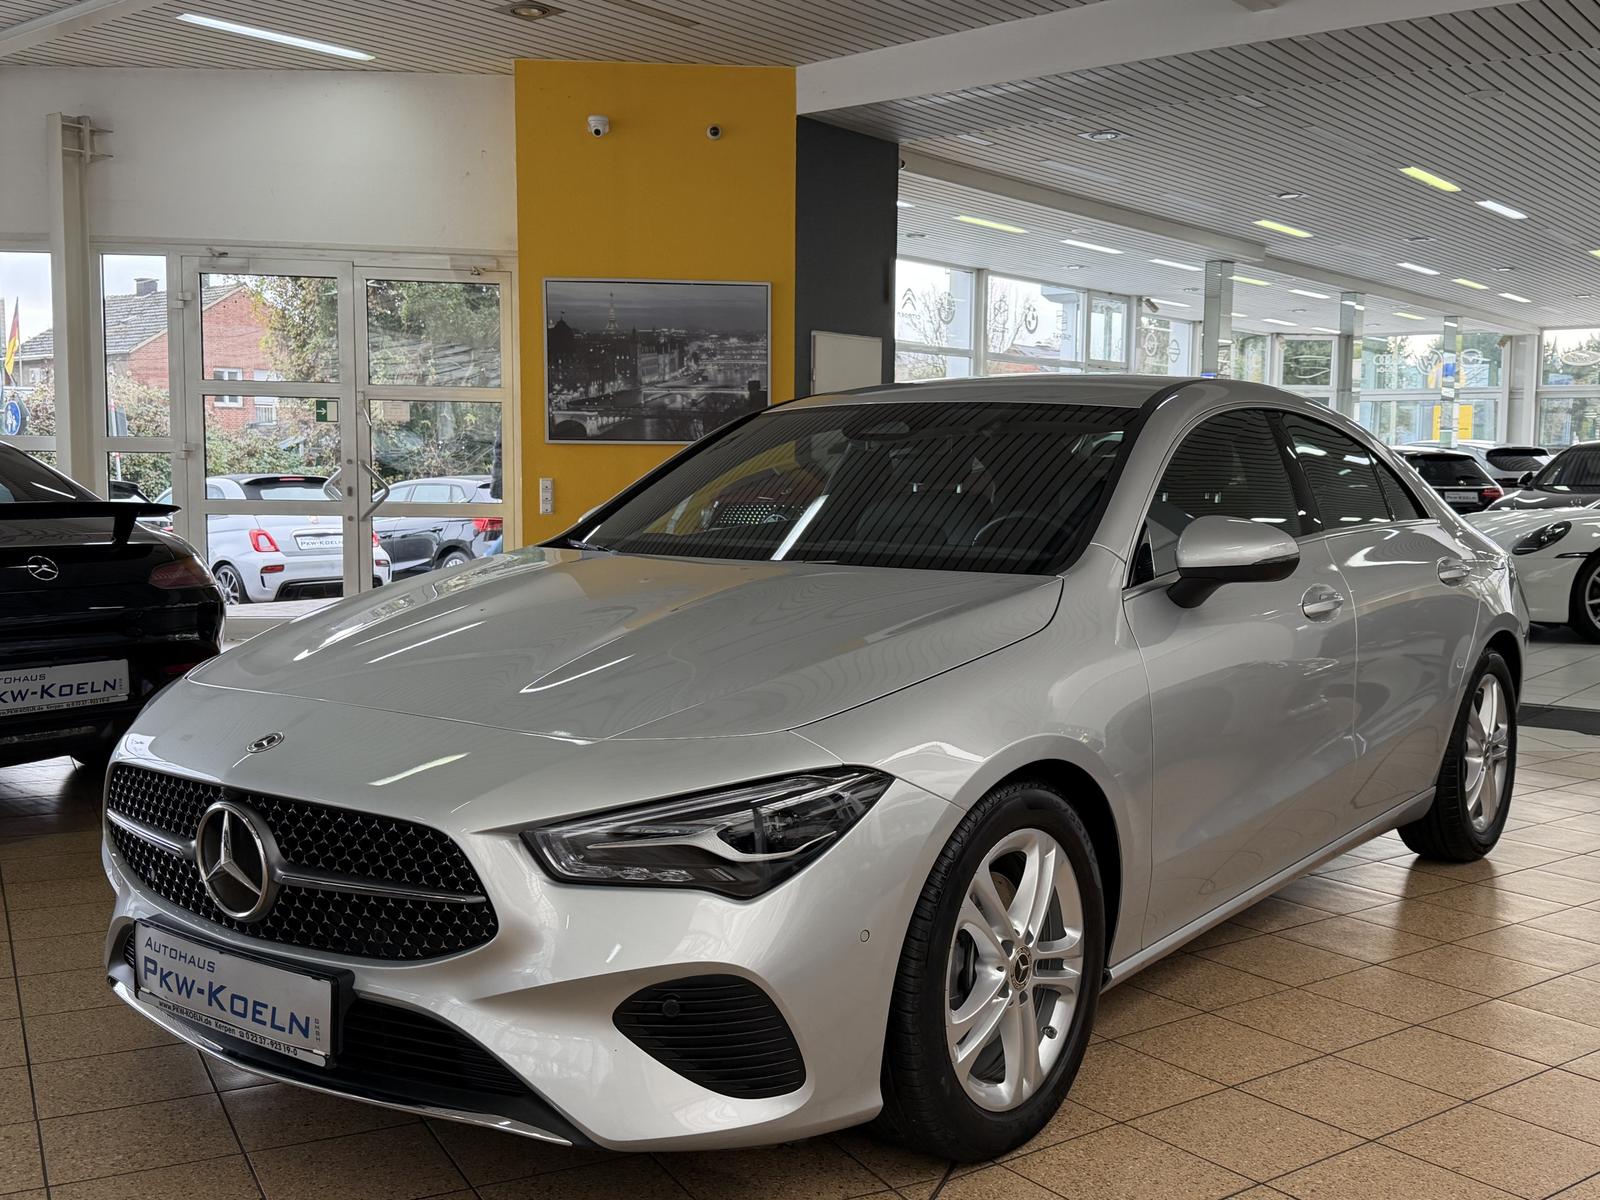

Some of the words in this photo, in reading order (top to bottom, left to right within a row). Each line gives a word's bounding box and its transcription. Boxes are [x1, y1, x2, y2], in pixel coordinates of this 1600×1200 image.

[0, 673, 46, 685] OHAUS
[144, 936, 216, 973] AUTOHAUS
[144, 956, 311, 1039] PKW-KOELN
[214, 1020, 236, 1035] Kerpen
